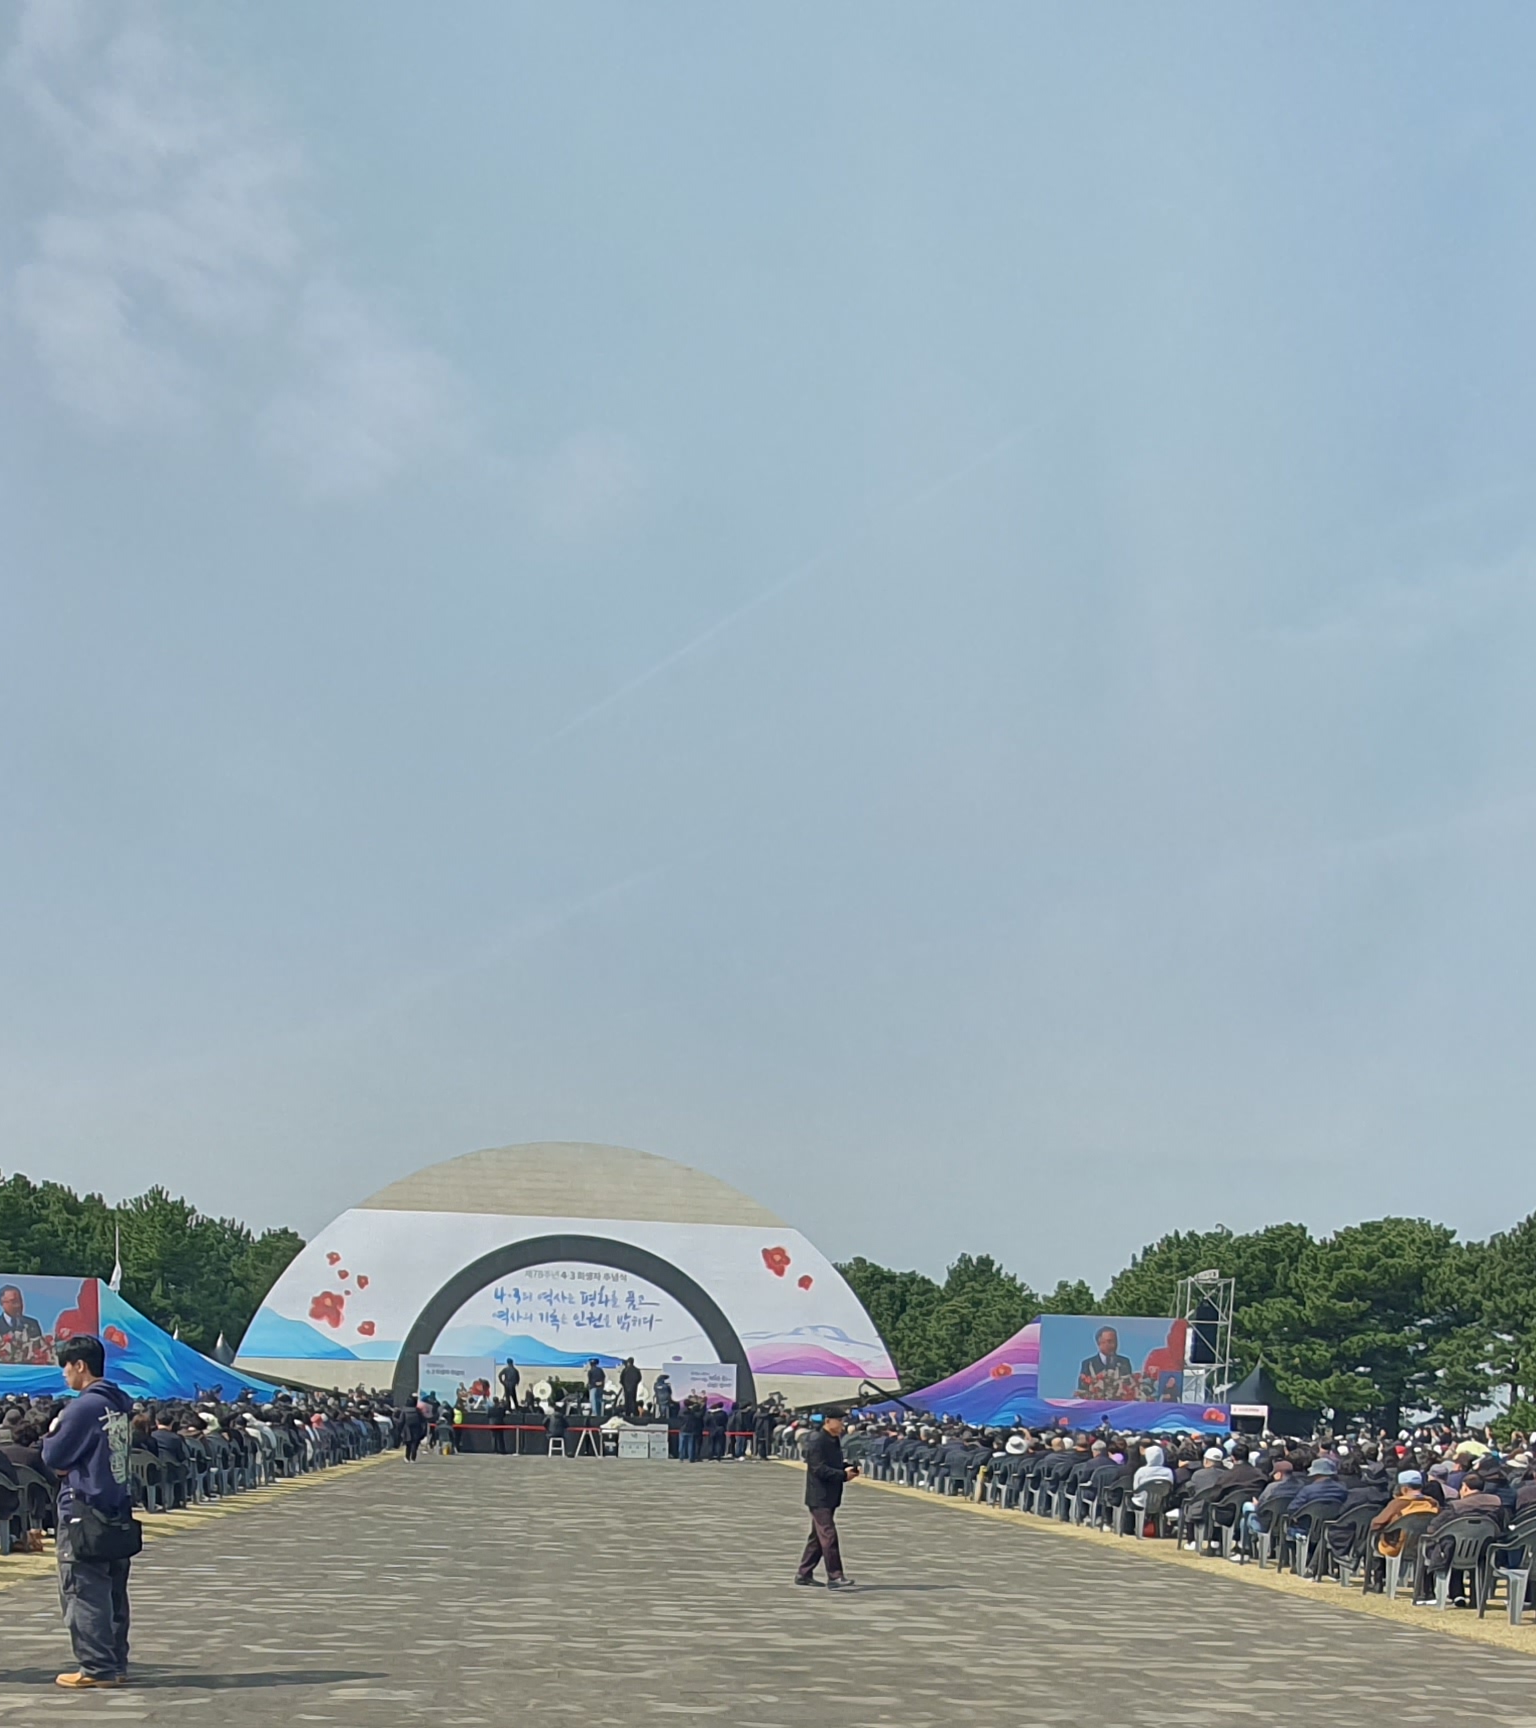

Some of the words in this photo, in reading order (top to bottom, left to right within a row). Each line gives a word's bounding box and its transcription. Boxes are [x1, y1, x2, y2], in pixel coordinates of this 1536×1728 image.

[603, 1273, 628, 1282] 추념식
[537, 1288, 576, 1306] 역사는
[579, 1285, 620, 1308] 평화를
[625, 1290, 660, 1310] 품고
[492, 1307, 533, 1327] 역사의
